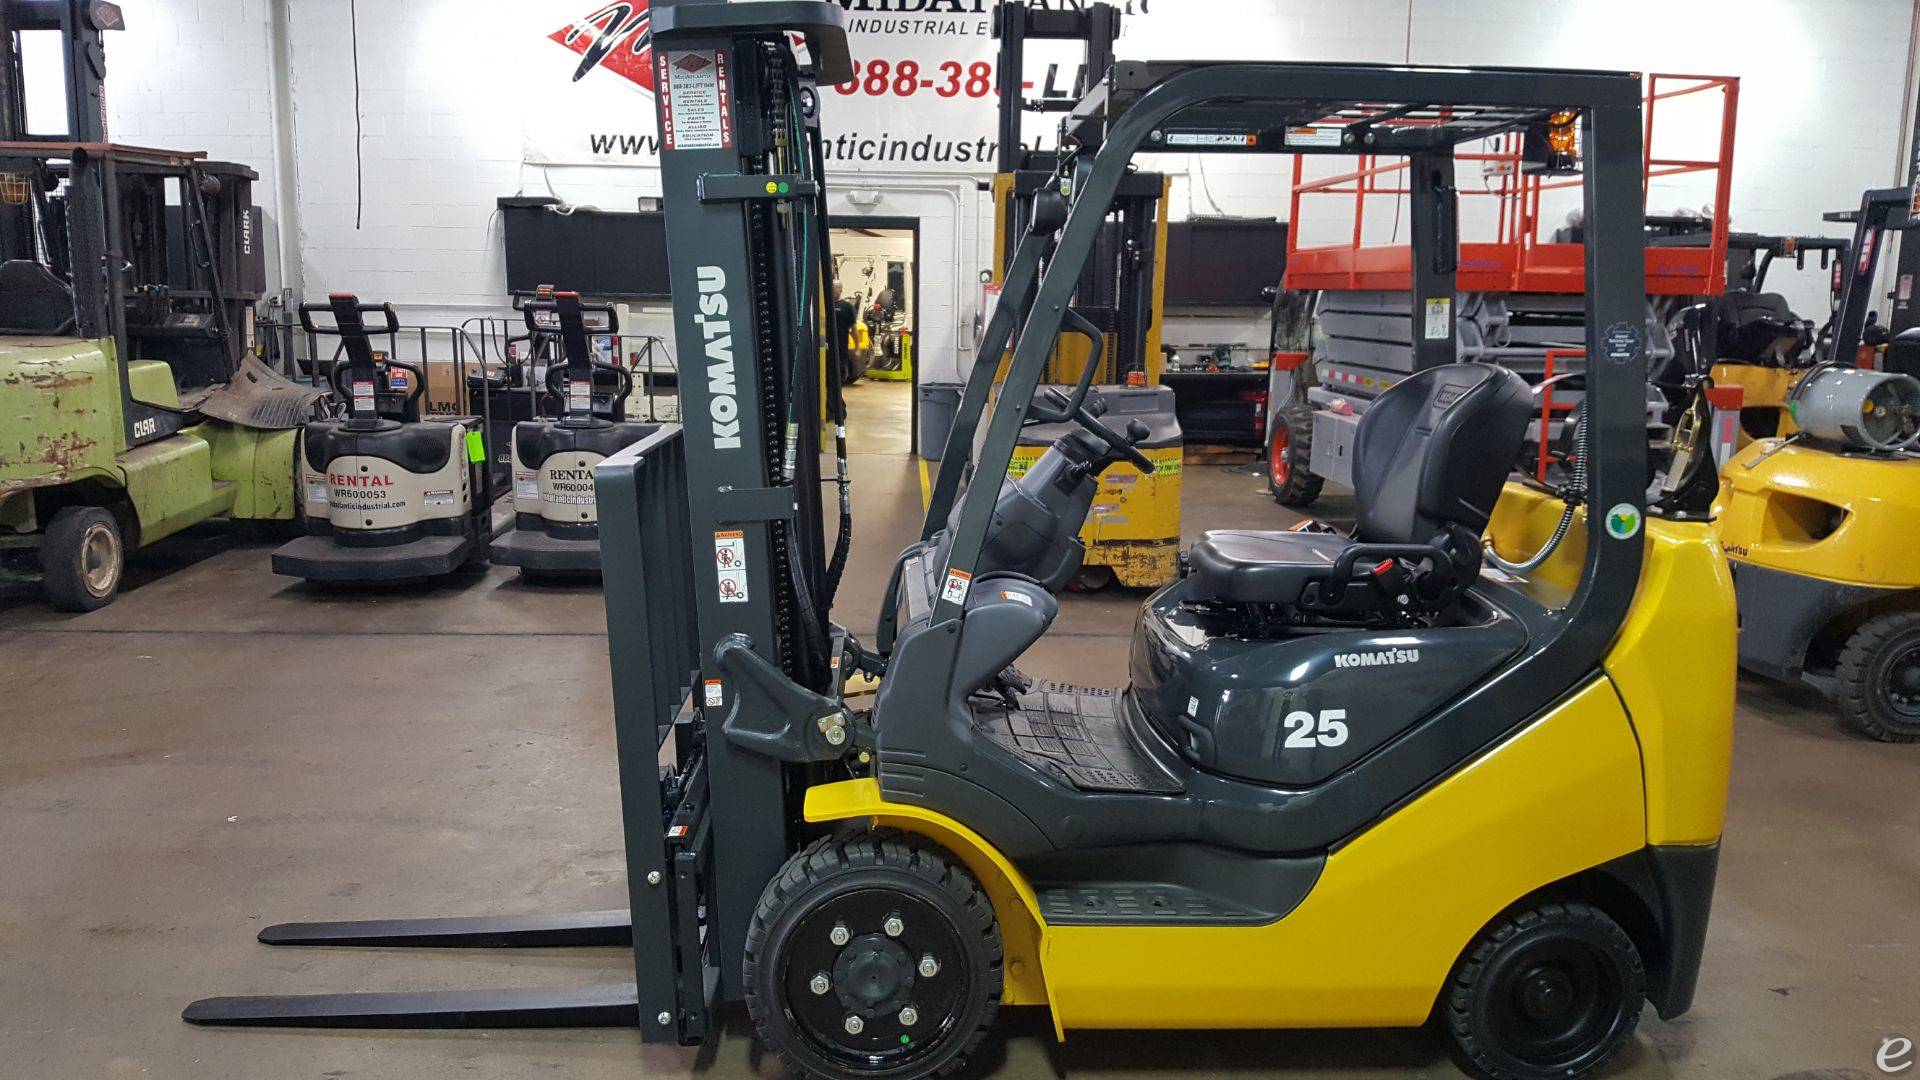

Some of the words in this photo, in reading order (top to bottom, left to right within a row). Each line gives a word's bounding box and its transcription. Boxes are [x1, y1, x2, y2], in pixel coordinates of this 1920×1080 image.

[848, 19, 968, 35] INDUSTRIAL
[659, 55, 673, 145] SERVICE
[717, 53, 730, 143] RENTALS
[694, 265, 742, 450] KOMATSU
[330, 474, 394, 487] RENTAL
[550, 469, 594, 480] RENTA
[1334, 647, 1419, 668] KOMATSU
[1283, 708, 1349, 749] 25
